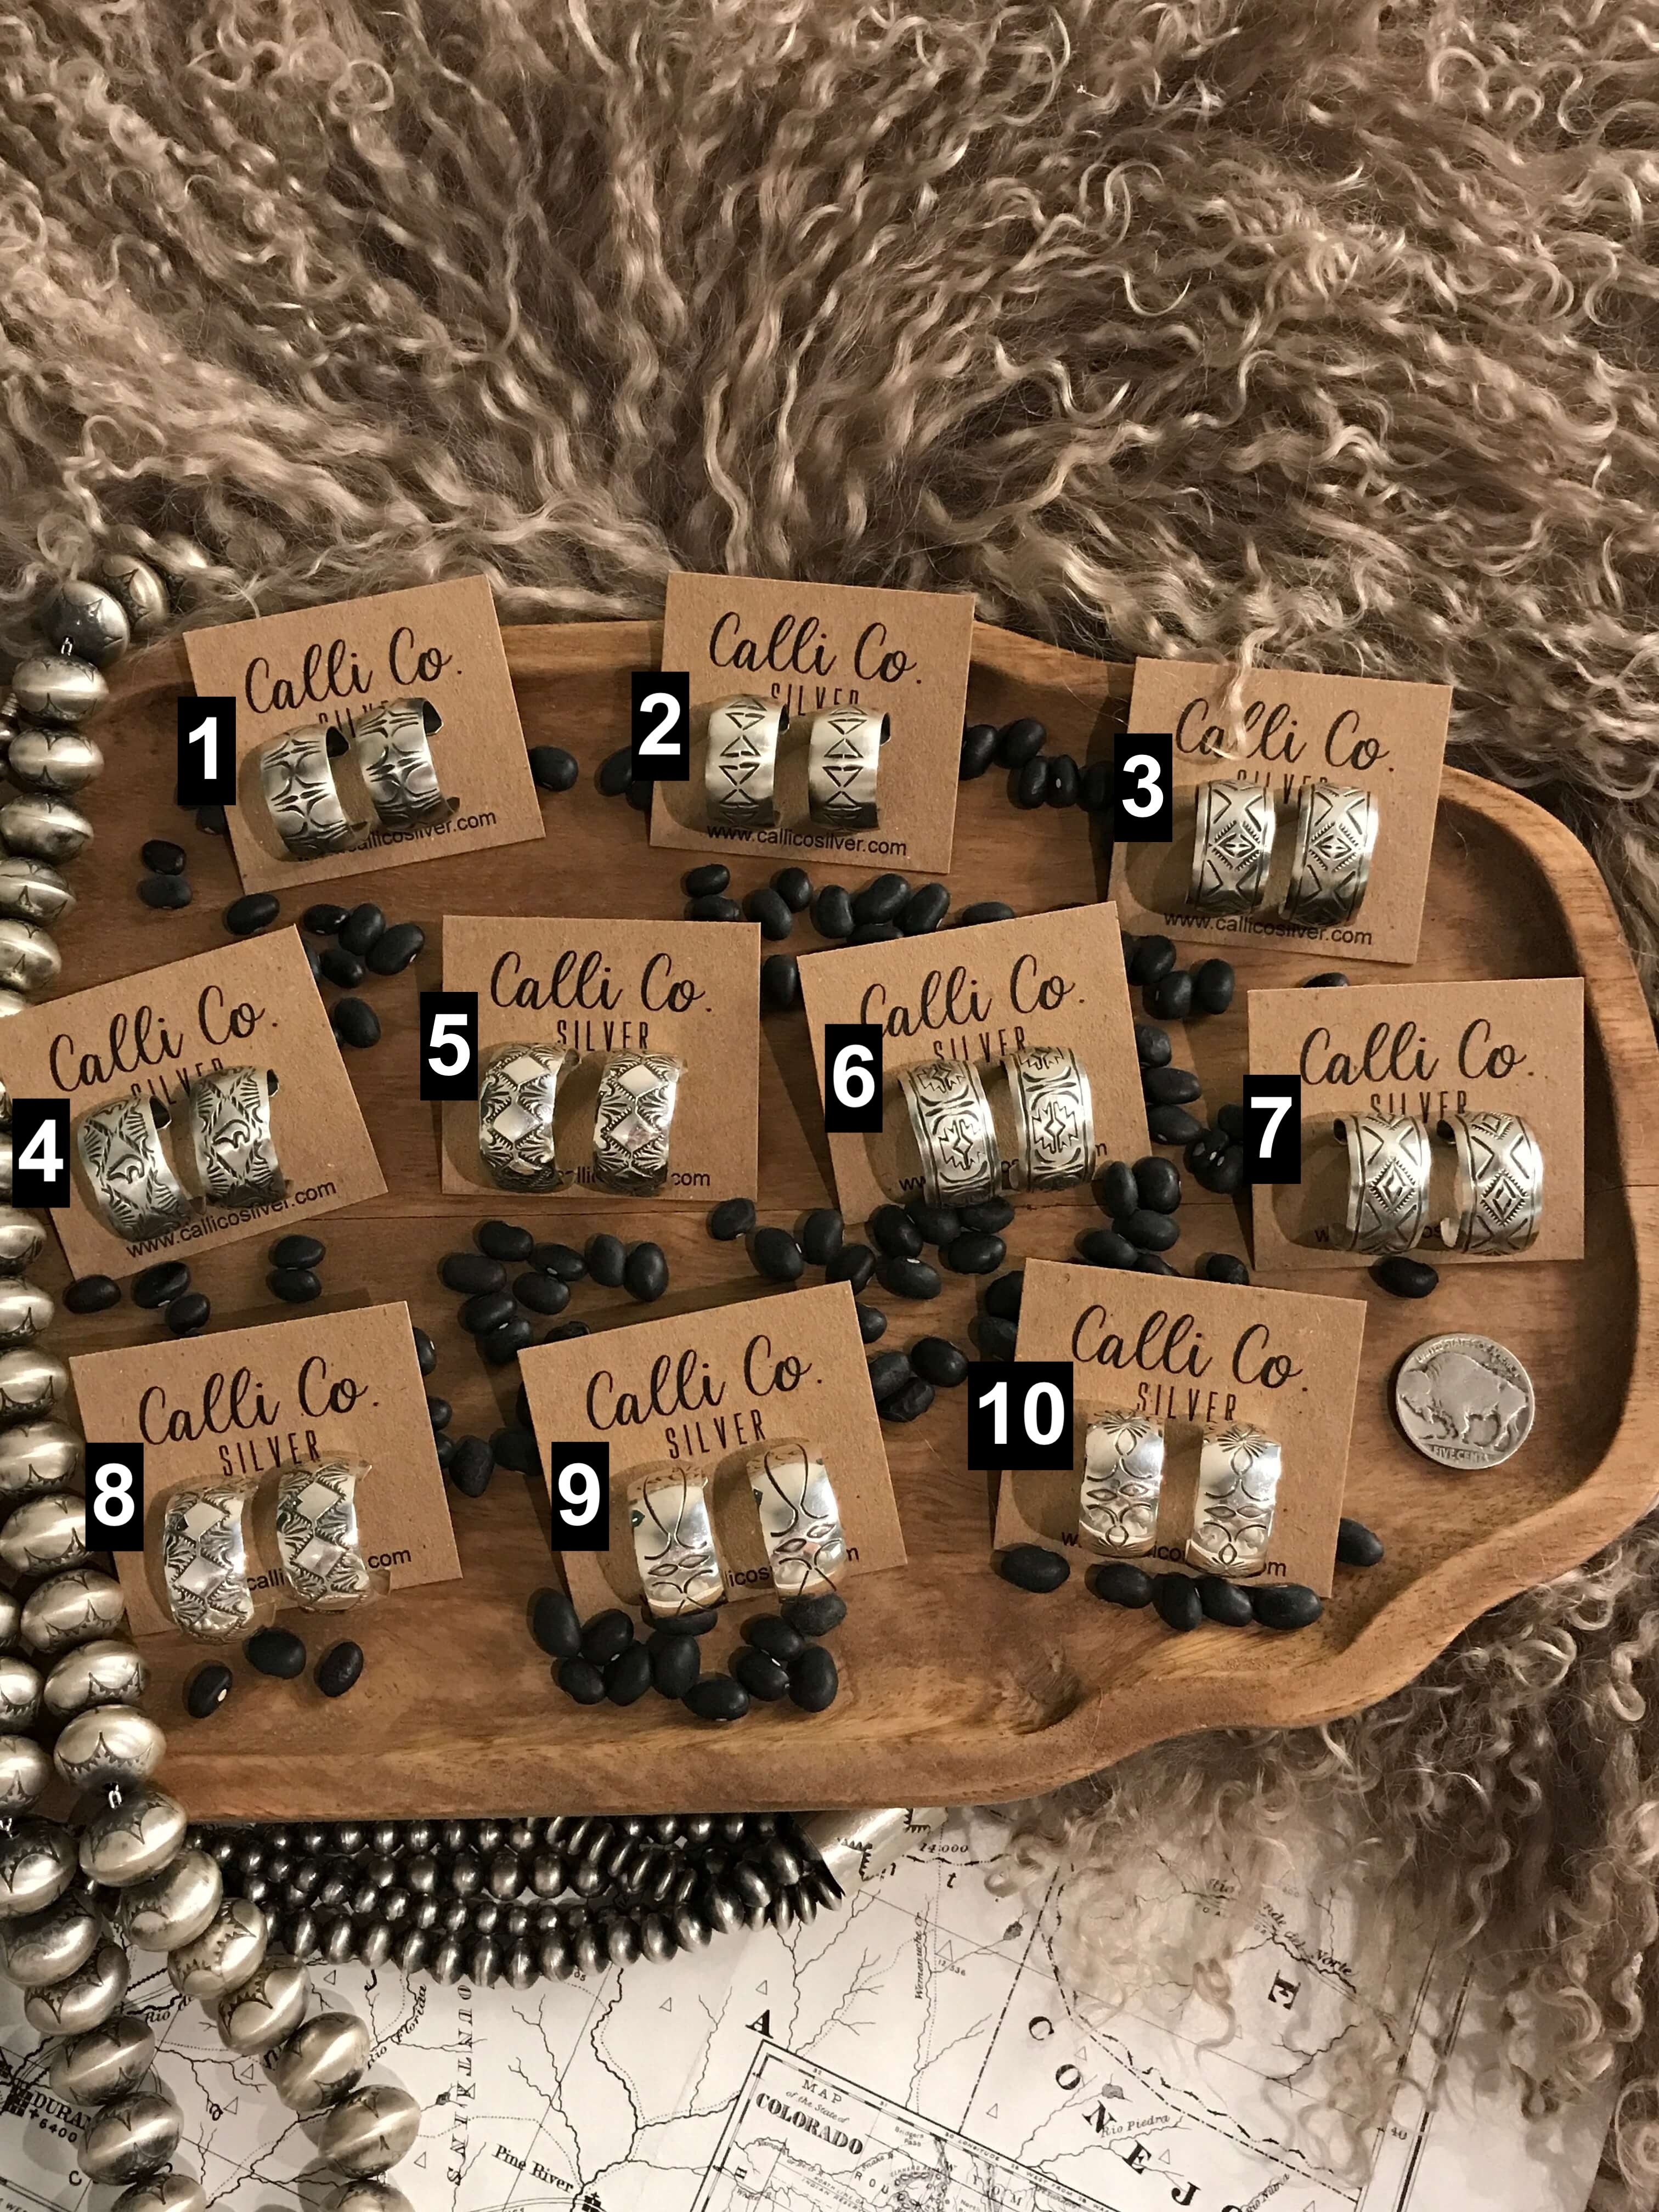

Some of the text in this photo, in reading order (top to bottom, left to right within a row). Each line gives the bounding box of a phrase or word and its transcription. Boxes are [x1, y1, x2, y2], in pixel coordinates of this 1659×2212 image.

[245, 627, 462, 713] Calli Co.
[709, 612, 922, 685] Calli Co.
[1325, 709, 1395, 772] Co.
[707, 825, 907, 857] www.callicosilver.com
[490, 951, 712, 1013] Calli Co.
[860, 954, 1085, 1037] Calli Co.
[49, 985, 279, 1092] Calli Co.
[557, 1020, 648, 1052] SILVER
[1300, 1018, 1534, 1086] Calli Co.
[1071, 1304, 1308, 1392] Calli Co.
[139, 1356, 380, 1446] Calli Co.
[586, 1334, 823, 1430] Calli Co.
[1137, 1382, 1236, 1422] SILVER
[218, 1430, 320, 1476] SILVER
[665, 1409, 766, 1459] SILVER
[802, 2079, 843, 2104] MAP
[39, 2118, 78, 2143] 6400
[755, 2092, 864, 2155] COLORADO
[1126, 2114, 1170, 2132] Piedra
[491, 2143, 574, 2194] Pine River
